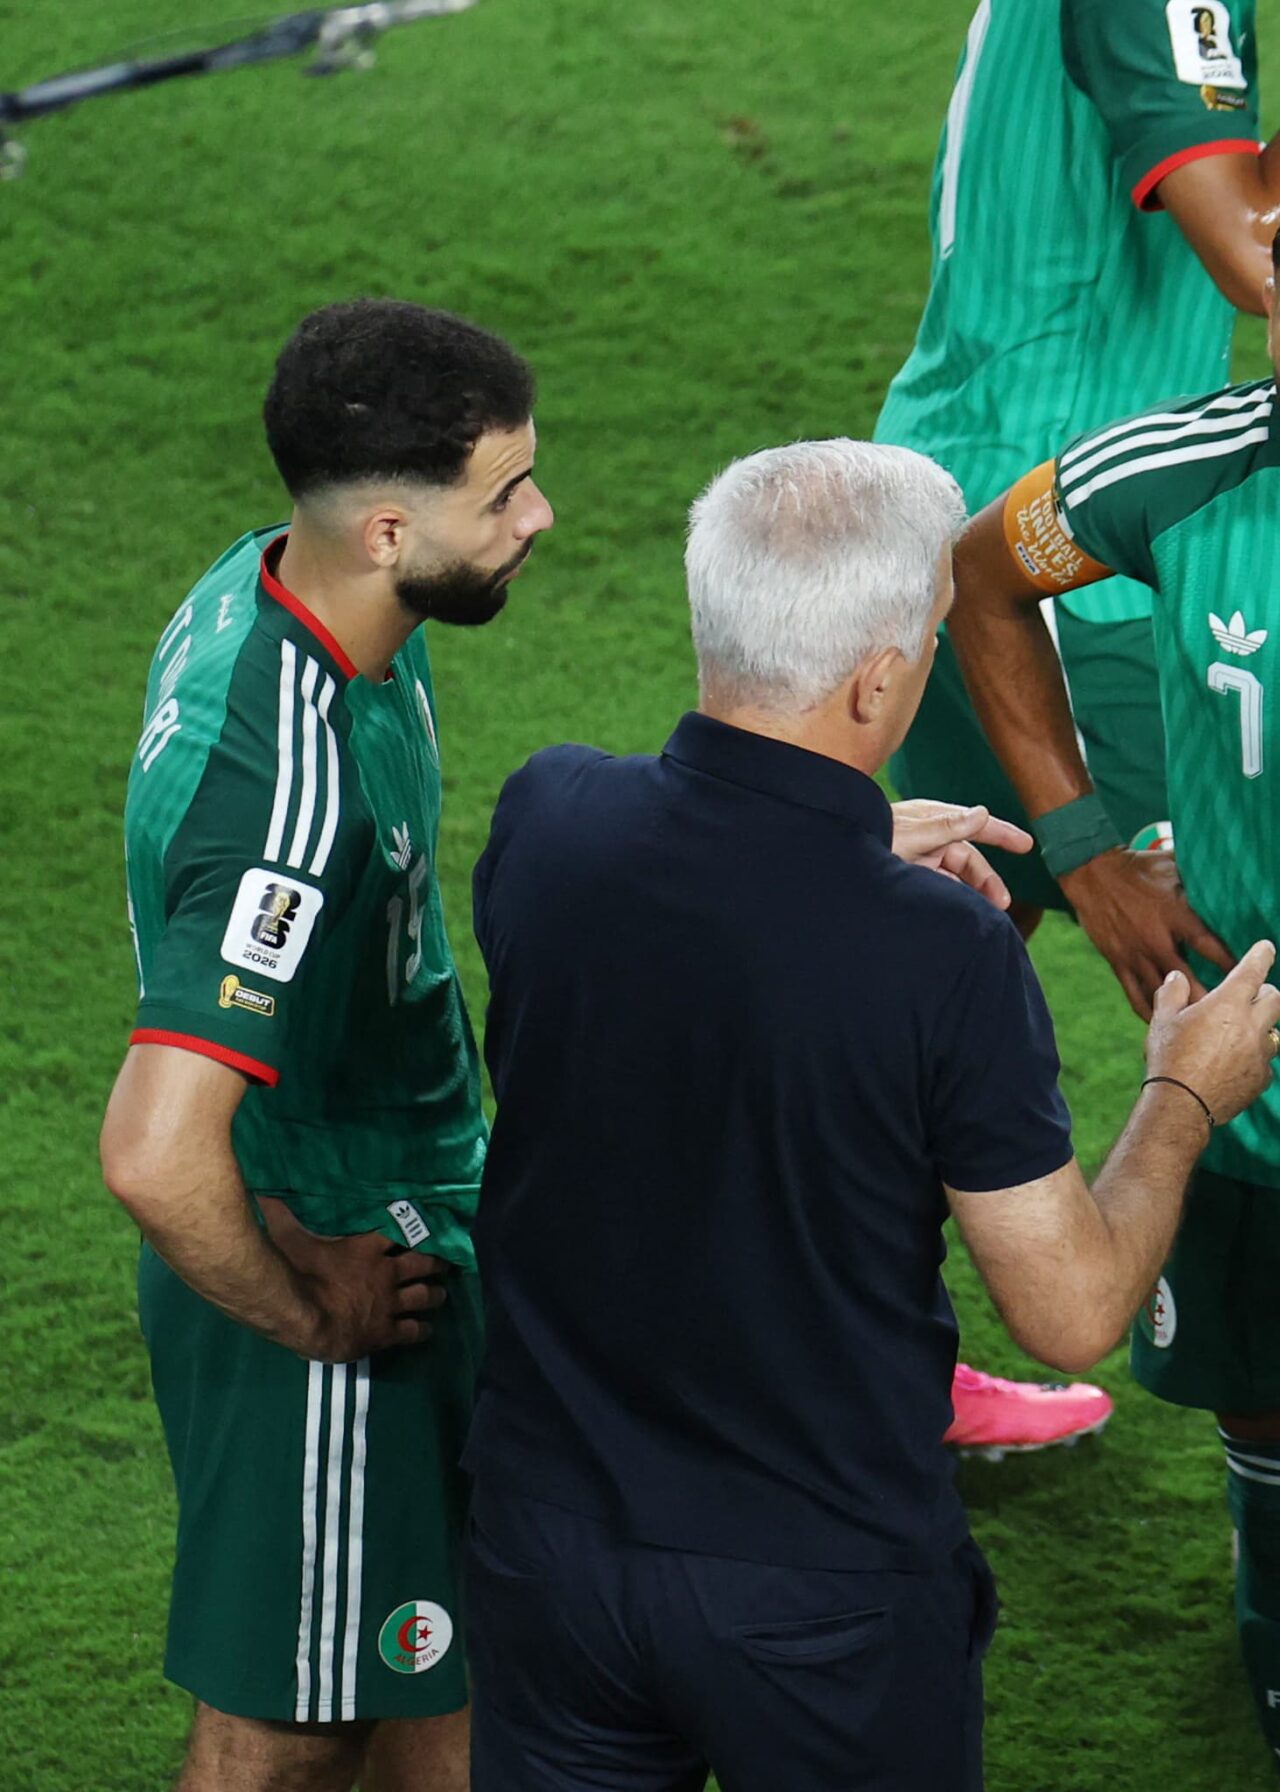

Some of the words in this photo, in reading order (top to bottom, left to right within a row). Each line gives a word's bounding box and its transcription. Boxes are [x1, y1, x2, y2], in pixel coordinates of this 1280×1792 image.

[1029, 498, 1077, 577] UNITES
[1041, 489, 1084, 571] FOOTBALL
[1207, 661, 1264, 780] 7
[260, 930, 278, 944] FIFA
[242, 949, 278, 969] 2026
[235, 989, 271, 1007] DEBUT
[394, 1647, 440, 1667] ALGERIA
